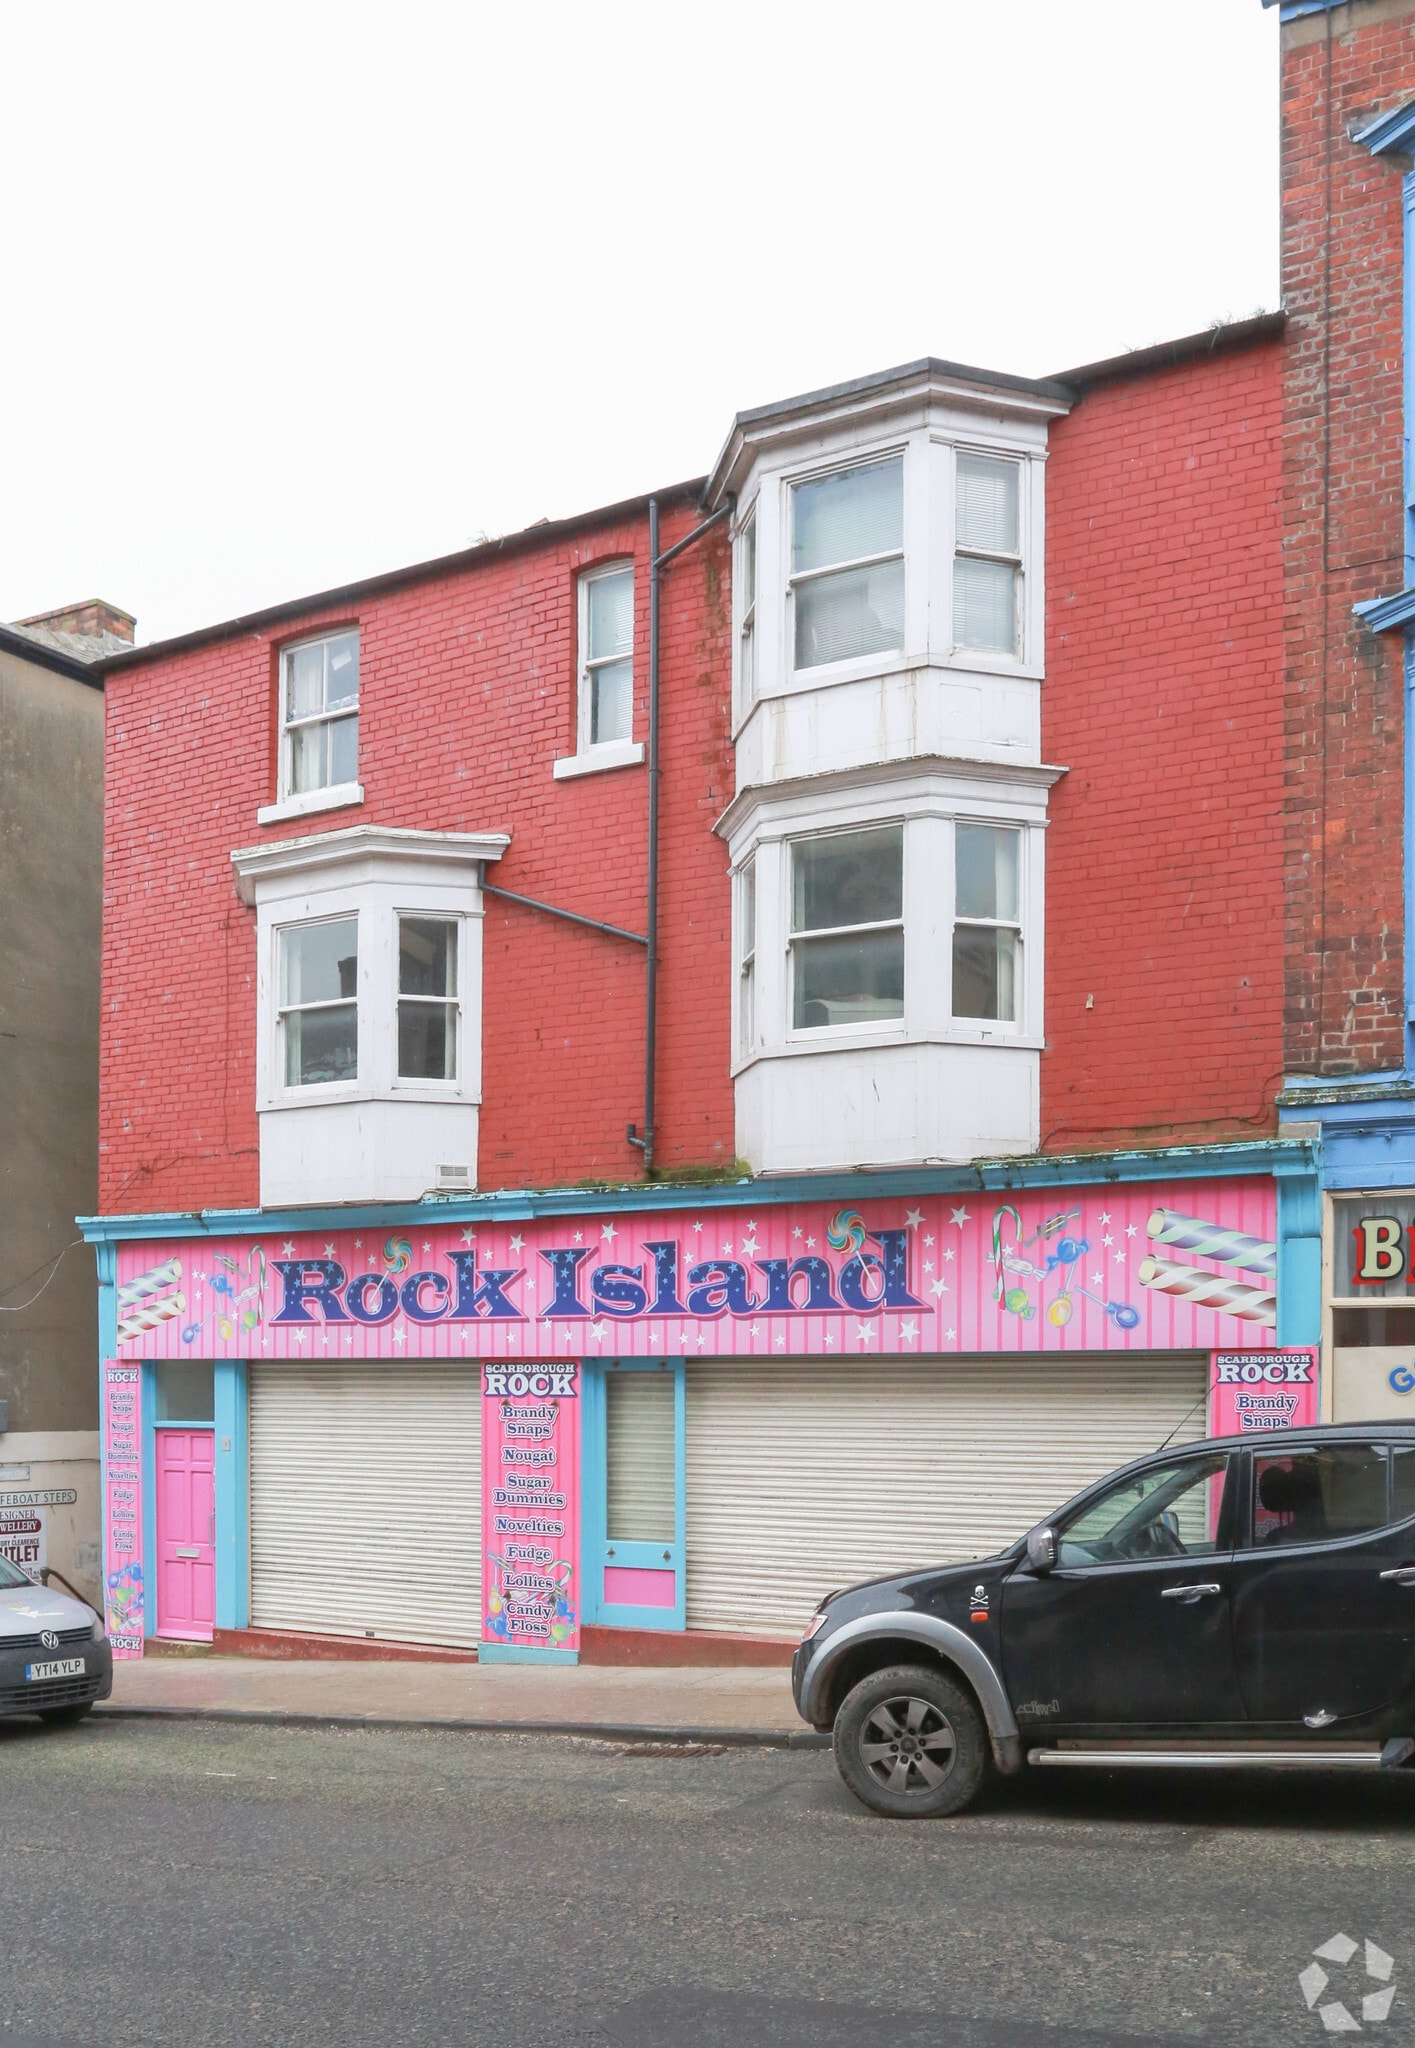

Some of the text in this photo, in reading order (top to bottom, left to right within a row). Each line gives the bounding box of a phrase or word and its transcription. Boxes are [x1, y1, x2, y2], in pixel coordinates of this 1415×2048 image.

[1352, 1216, 1415, 1284] B
[270, 1226, 934, 1325] Rock Island
[1217, 1355, 1311, 1364] SCARBOROUGH
[485, 1364, 575, 1373] SCARBOROUGH
[1216, 1363, 1312, 1383] ROCK
[107, 1373, 138, 1383] ROCK
[484, 1373, 576, 1396] ROCK
[110, 1393, 134, 1402] Brandy
[1238, 1396, 1295, 1411] Brandy
[112, 1405, 132, 1414] Snaps
[502, 1407, 556, 1420] Brandy
[111, 1423, 134, 1431] Nougat
[1243, 1413, 1289, 1428] Snaps
[507, 1423, 551, 1437] Snaps
[113, 1442, 132, 1450] Sugar
[504, 1449, 555, 1463] Nougat
[507, 1476, 551, 1490] Sugar
[0, 1491, 73, 1505] FEBOAT STEPS
[113, 1491, 133, 1499] Fudge
[495, 1492, 564, 1505] Dummies
[497, 1519, 563, 1533] Novelties
[113, 1530, 134, 1540] Candy
[114, 1542, 133, 1550] Floss
[507, 1546, 551, 1561] Fudge
[505, 1575, 553, 1588] Lollies
[506, 1602, 552, 1619] Candy
[509, 1619, 548, 1633] Floss
[109, 1638, 140, 1650] ROCK
[35, 1660, 81, 1677] YT14 YLP
